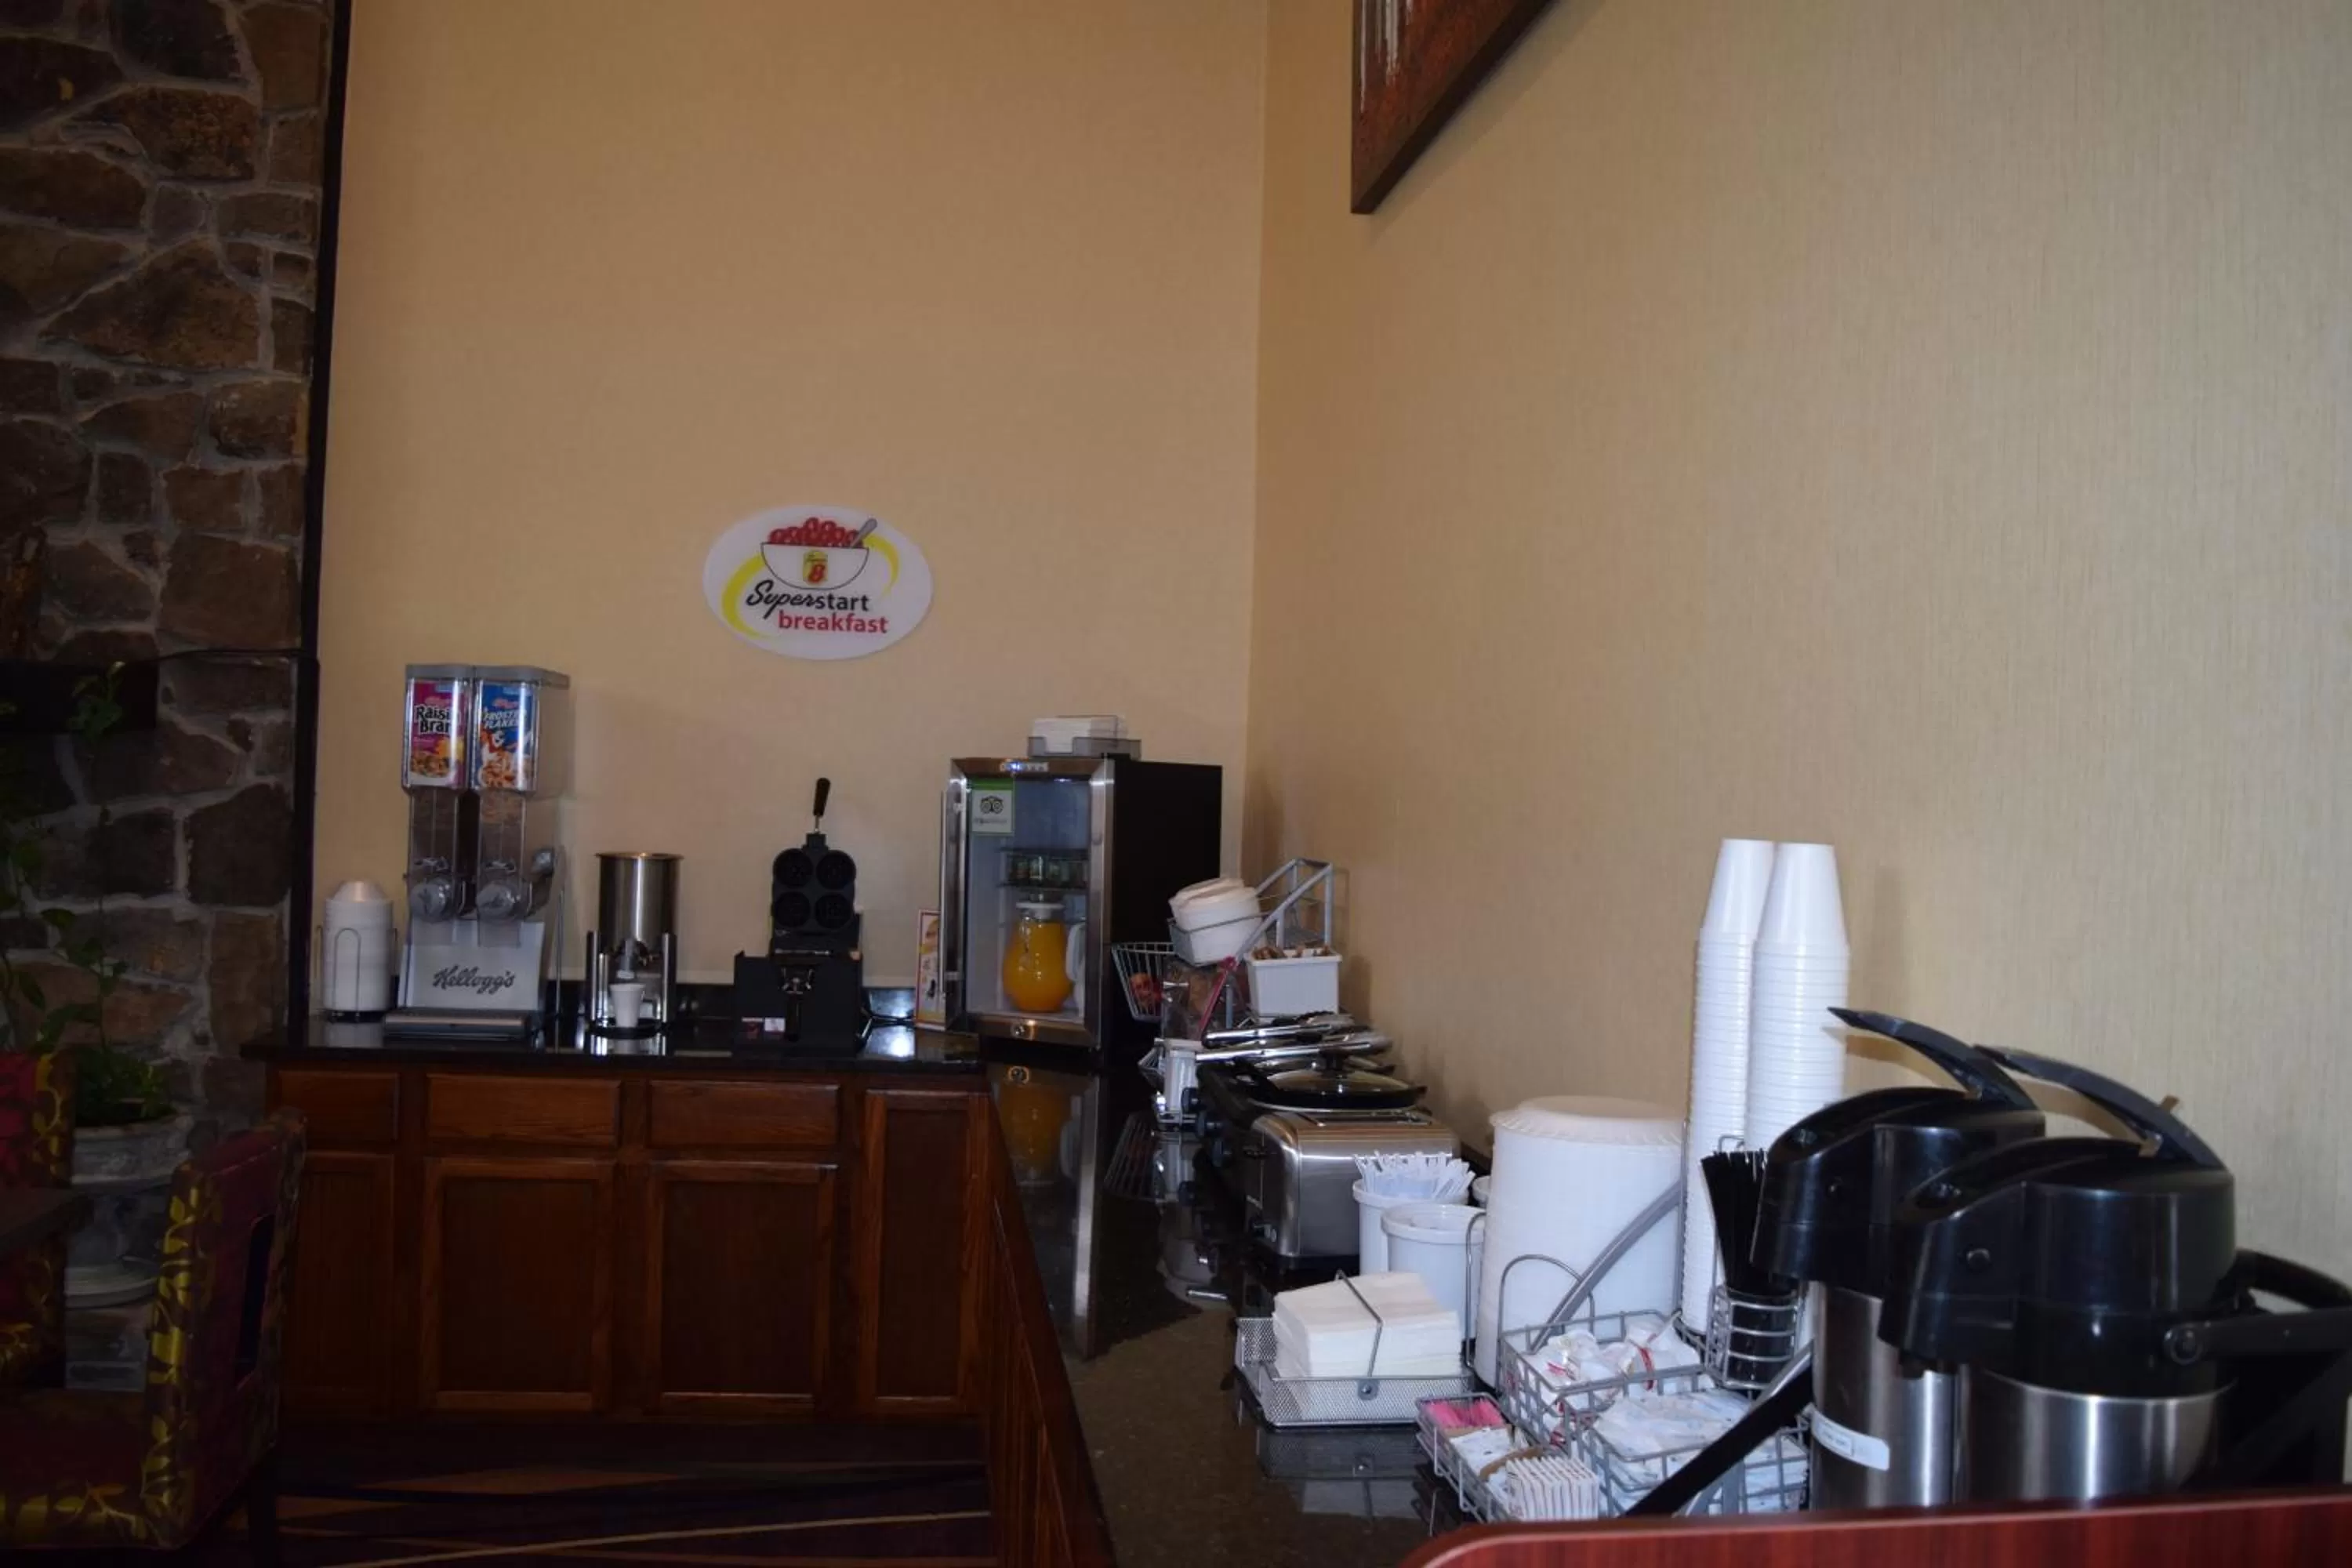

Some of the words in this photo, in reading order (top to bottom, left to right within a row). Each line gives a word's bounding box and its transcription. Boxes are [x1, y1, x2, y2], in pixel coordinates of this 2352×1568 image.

[746, 579, 869, 619] Superstart
[778, 610, 889, 633] breakfast
[416, 706, 456, 720] Raisi
[432, 964, 515, 994] Kellogg's
